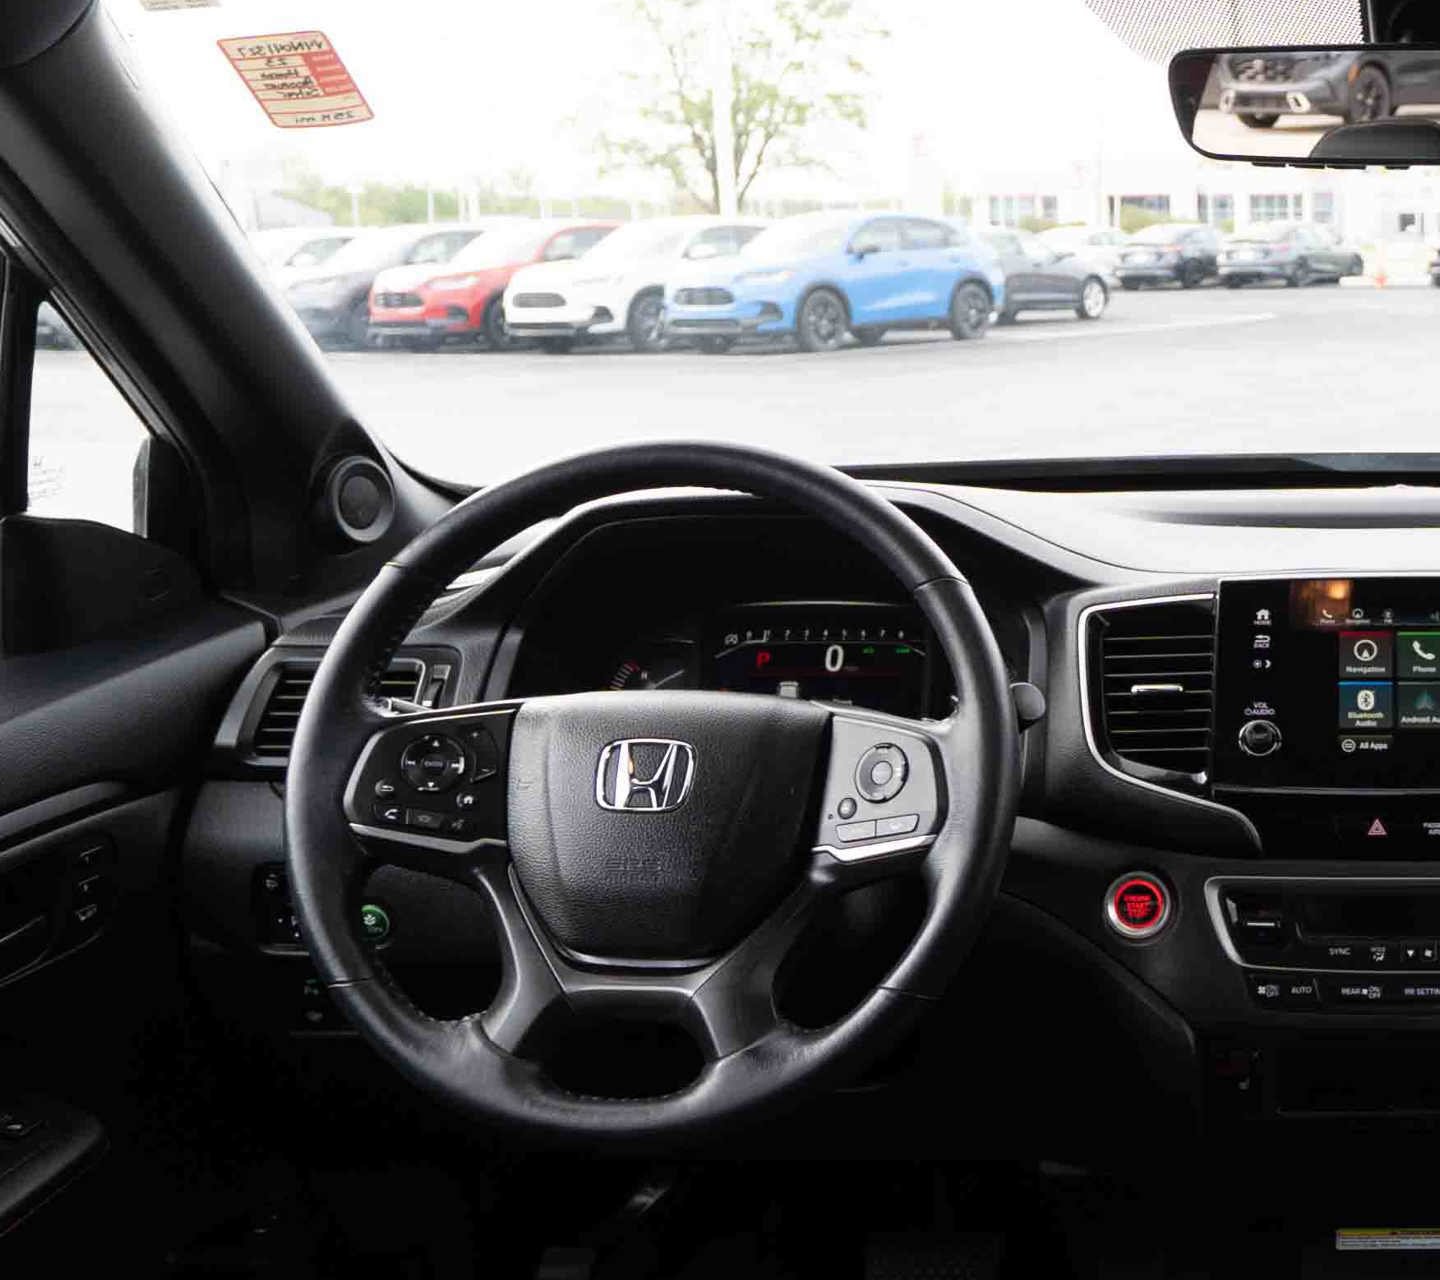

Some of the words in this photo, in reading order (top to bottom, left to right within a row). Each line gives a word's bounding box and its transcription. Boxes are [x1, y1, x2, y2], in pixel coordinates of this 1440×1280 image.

[755, 648, 772, 669] P
[825, 644, 845, 673] 0
[1345, 665, 1386, 675] Navigation
[1412, 665, 1437, 673] Phone
[1347, 711, 1384, 719] Bluetooth
[1354, 719, 1378, 727] Audio
[1400, 716, 1430, 724] Android
[1359, 741, 1369, 750] All
[1370, 741, 1389, 751] Apps
[1328, 947, 1352, 957] SYNC
[1290, 985, 1313, 994] AUTO
